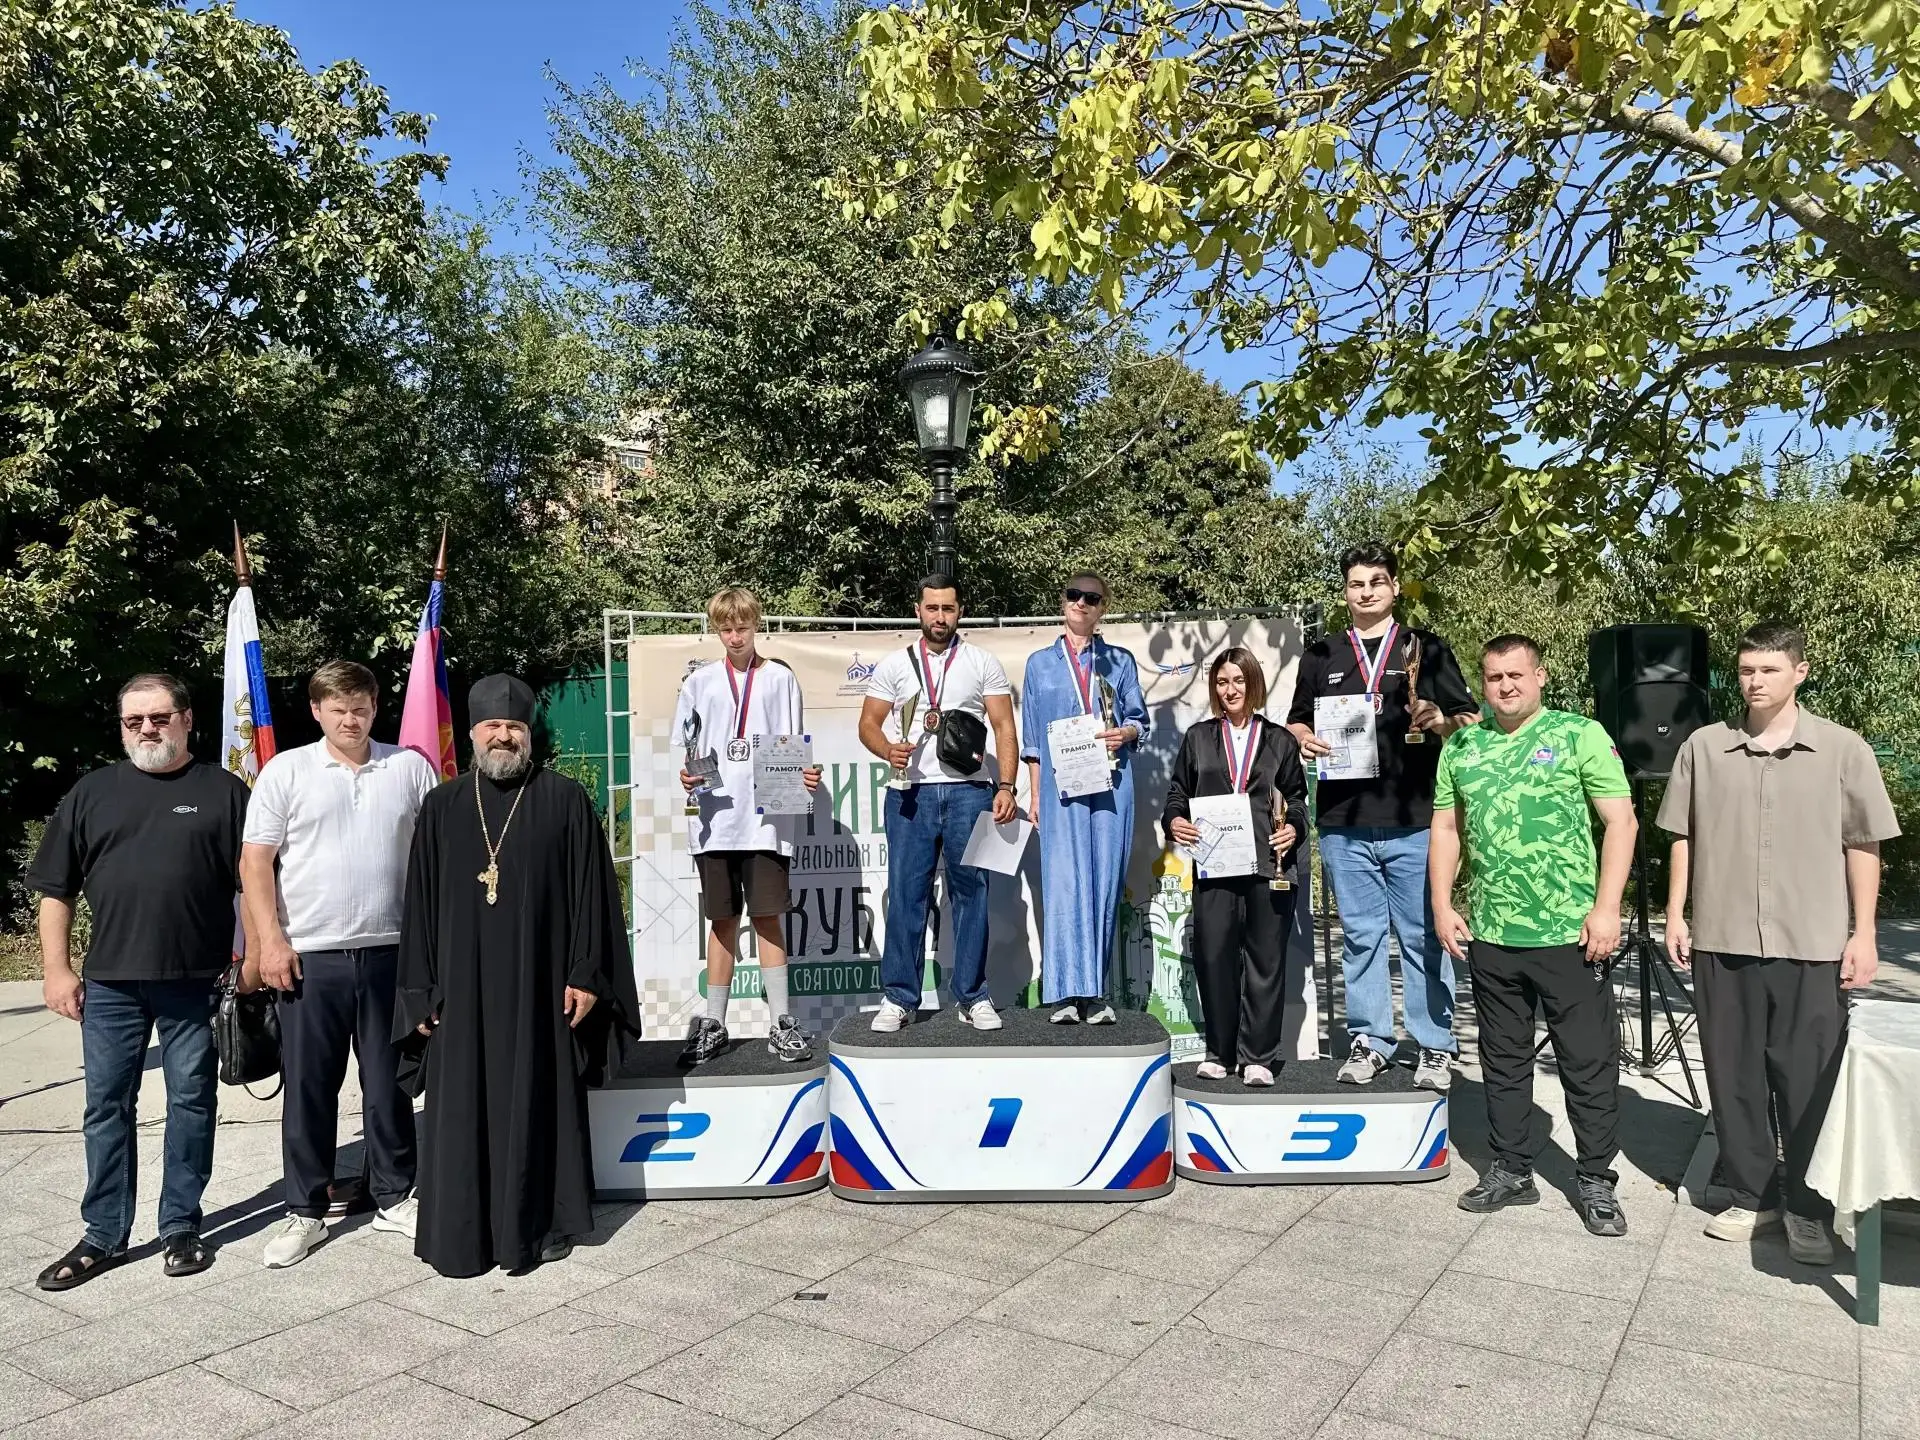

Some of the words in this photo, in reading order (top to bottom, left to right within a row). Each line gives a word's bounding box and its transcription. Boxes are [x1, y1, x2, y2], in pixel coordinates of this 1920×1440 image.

[1061, 742, 1097, 755] ГРАМОТА
[791, 843, 871, 871] УАЛЬНЫХ
[793, 966, 864, 992] СВЯТОГО
[619, 1112, 712, 1163] 2
[979, 1097, 1023, 1148] 1
[1281, 1113, 1367, 1162] 3
